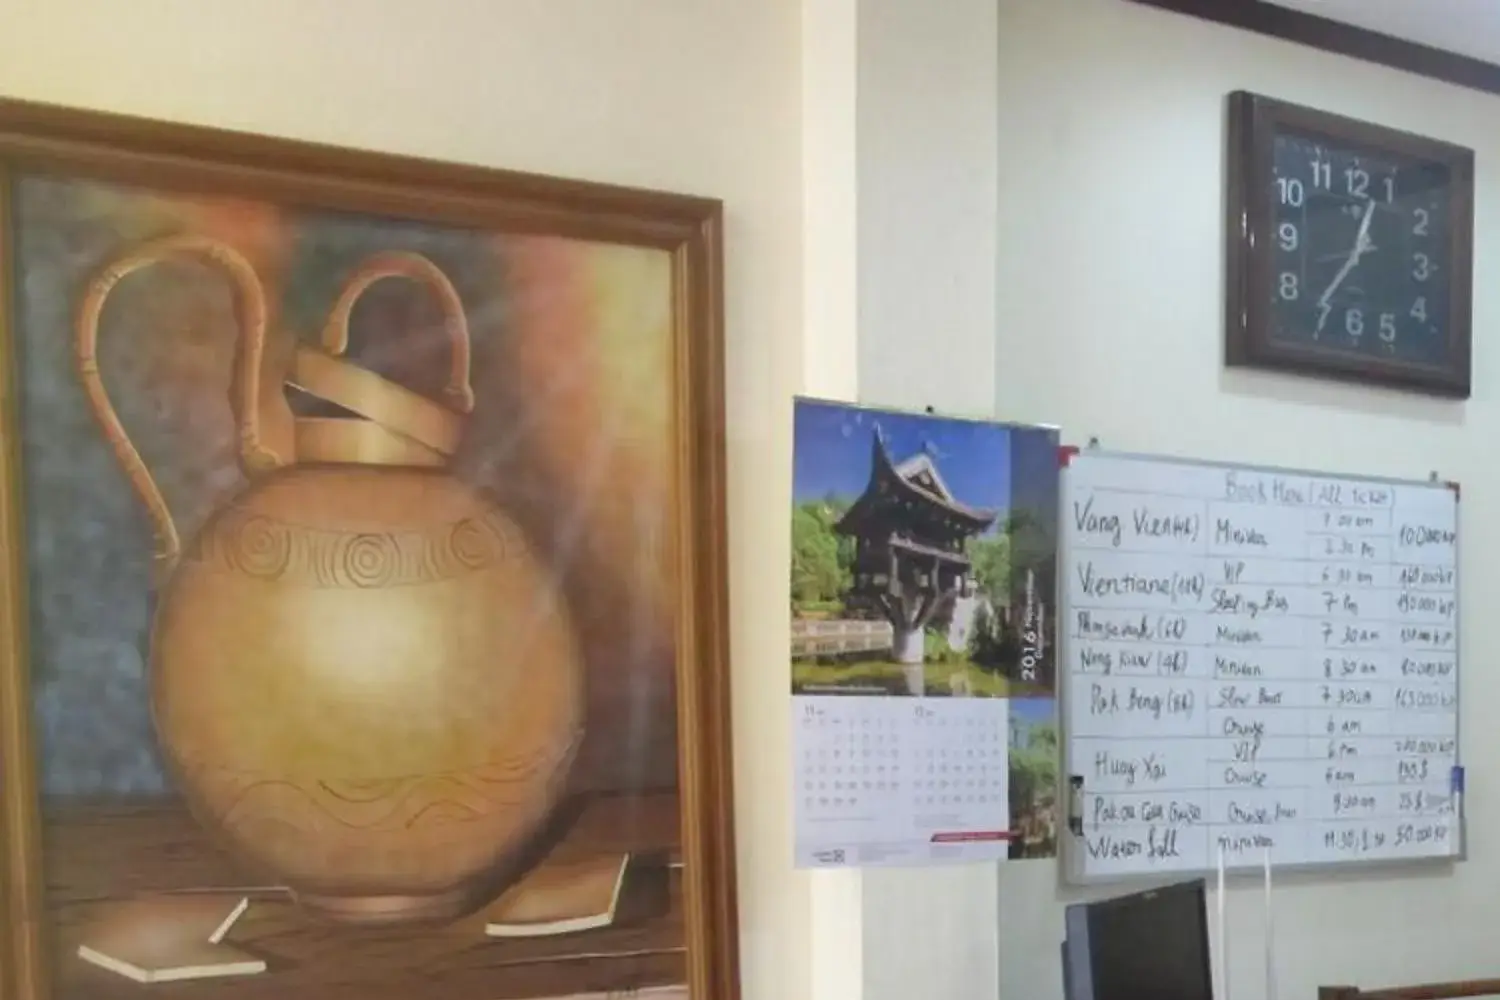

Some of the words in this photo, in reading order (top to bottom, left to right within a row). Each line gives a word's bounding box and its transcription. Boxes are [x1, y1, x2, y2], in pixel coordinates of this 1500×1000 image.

[1310, 159, 1332, 190] 11
[1345, 168, 1370, 198] 12
[1276, 177, 1304, 207] 10
[1384, 177, 1394, 203] 1
[1413, 208, 1429, 236] 2
[1279, 223, 1298, 251] 9
[1413, 253, 1429, 281] 3
[1279, 272, 1298, 300] 8
[1346, 309, 1364, 336] 6
[1410, 296, 1427, 322] 4
[1379, 312, 1396, 342] 5
[1073, 495, 1122, 548] Vang
[1021, 630, 1037, 681] 2016
